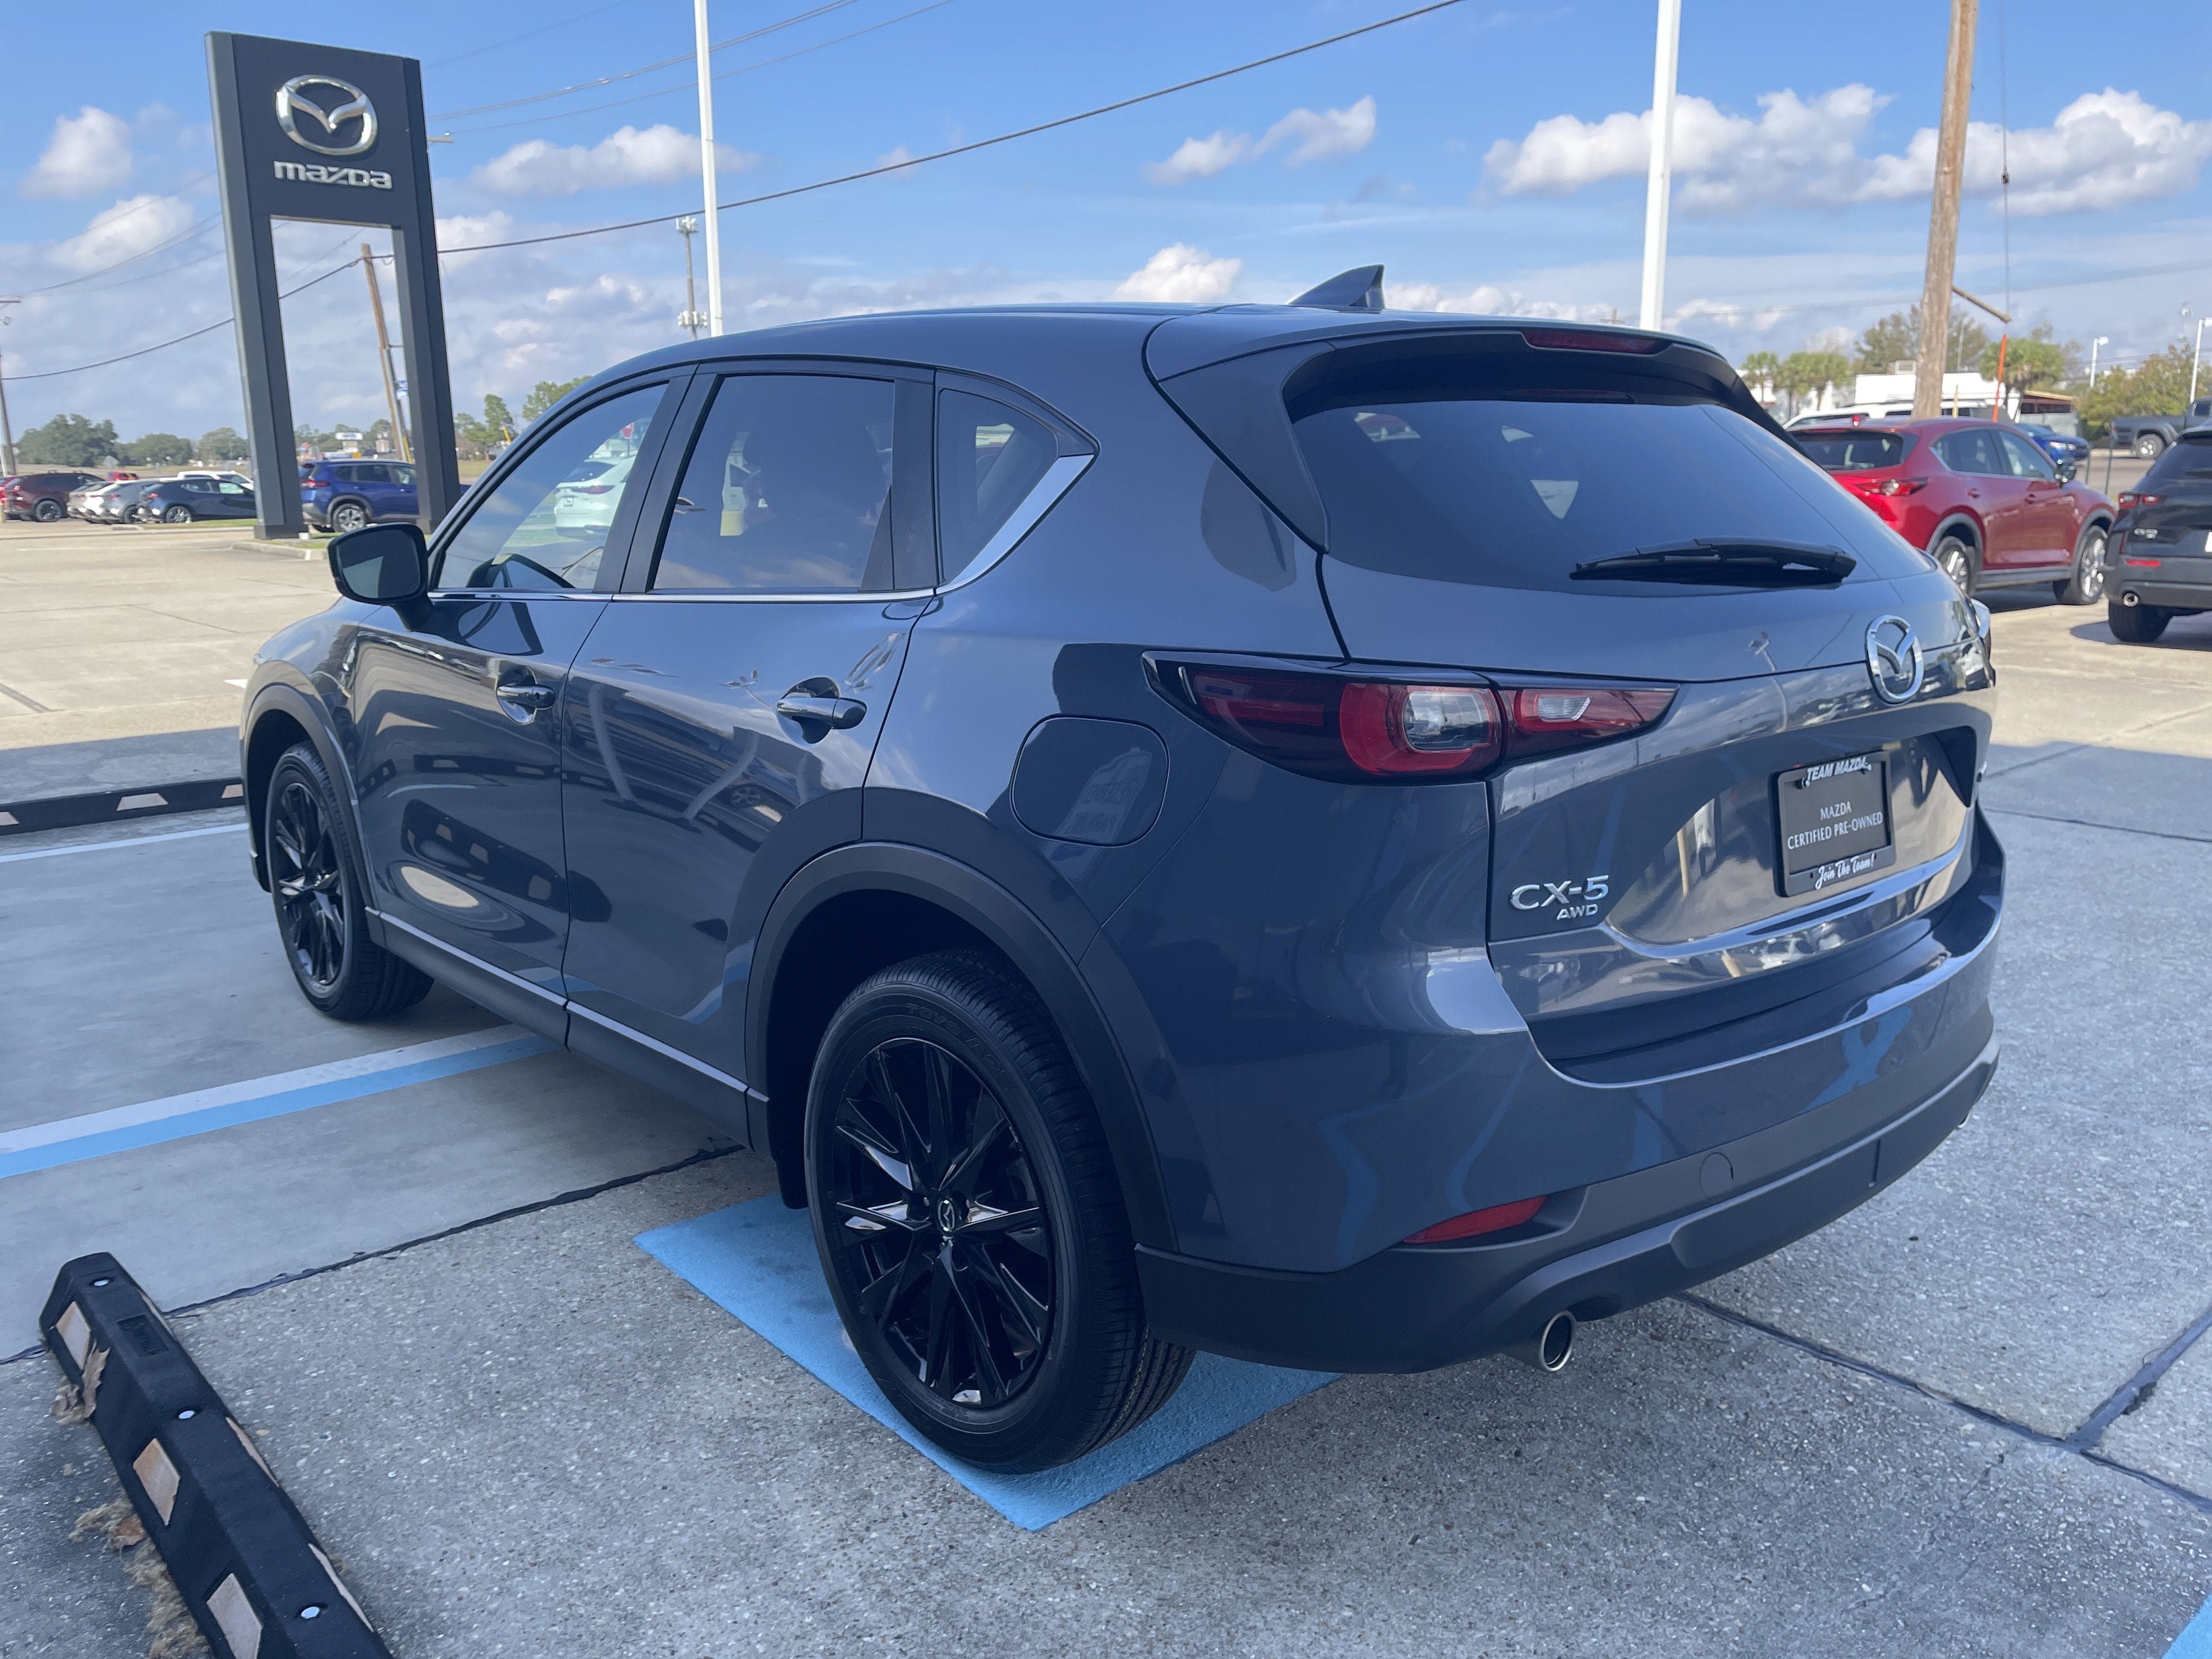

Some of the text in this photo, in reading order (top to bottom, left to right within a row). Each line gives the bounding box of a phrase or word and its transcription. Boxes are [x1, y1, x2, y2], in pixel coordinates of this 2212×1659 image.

[1807, 757, 1866, 781] TEAM MAZDA
[1820, 800, 1852, 821] MAZDA
[1787, 811, 1883, 850] CERTIFIED PRE-OWNED
[1815, 853, 1875, 890] Join The Team!
[1510, 874, 1609, 910] CX-5
[1556, 904, 1599, 921] AWD
[905, 1003, 961, 1036] TOYO
